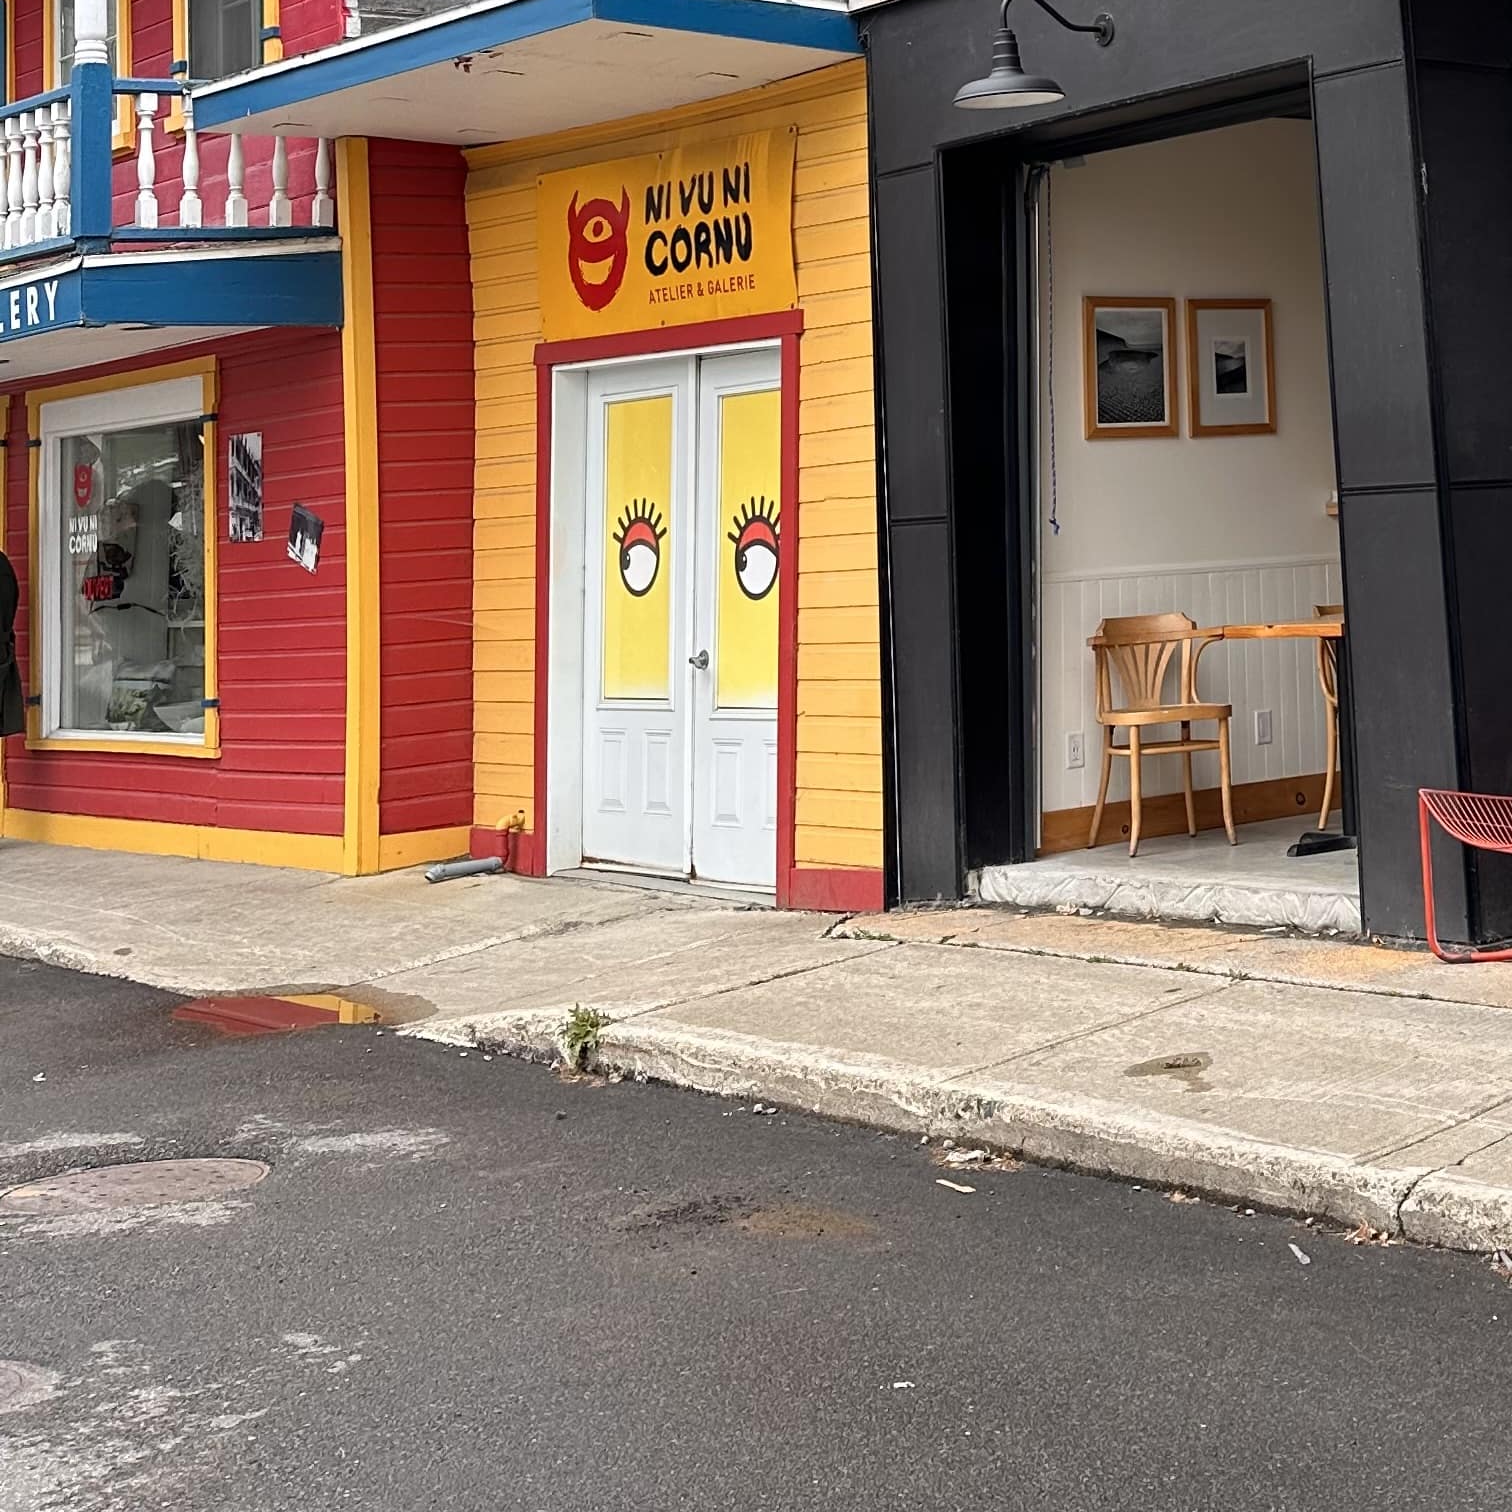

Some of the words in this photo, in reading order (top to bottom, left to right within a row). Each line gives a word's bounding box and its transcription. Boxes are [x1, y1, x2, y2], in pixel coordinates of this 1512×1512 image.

[645, 181, 671, 225] NI
[679, 170, 714, 217] VU
[723, 162, 750, 208] NI
[645, 212, 752, 276] CORNU
[0, 280, 59, 334] ERY
[649, 283, 693, 305] ATELIER
[697, 282, 704, 297] &
[707, 274, 756, 295] GALERIE
